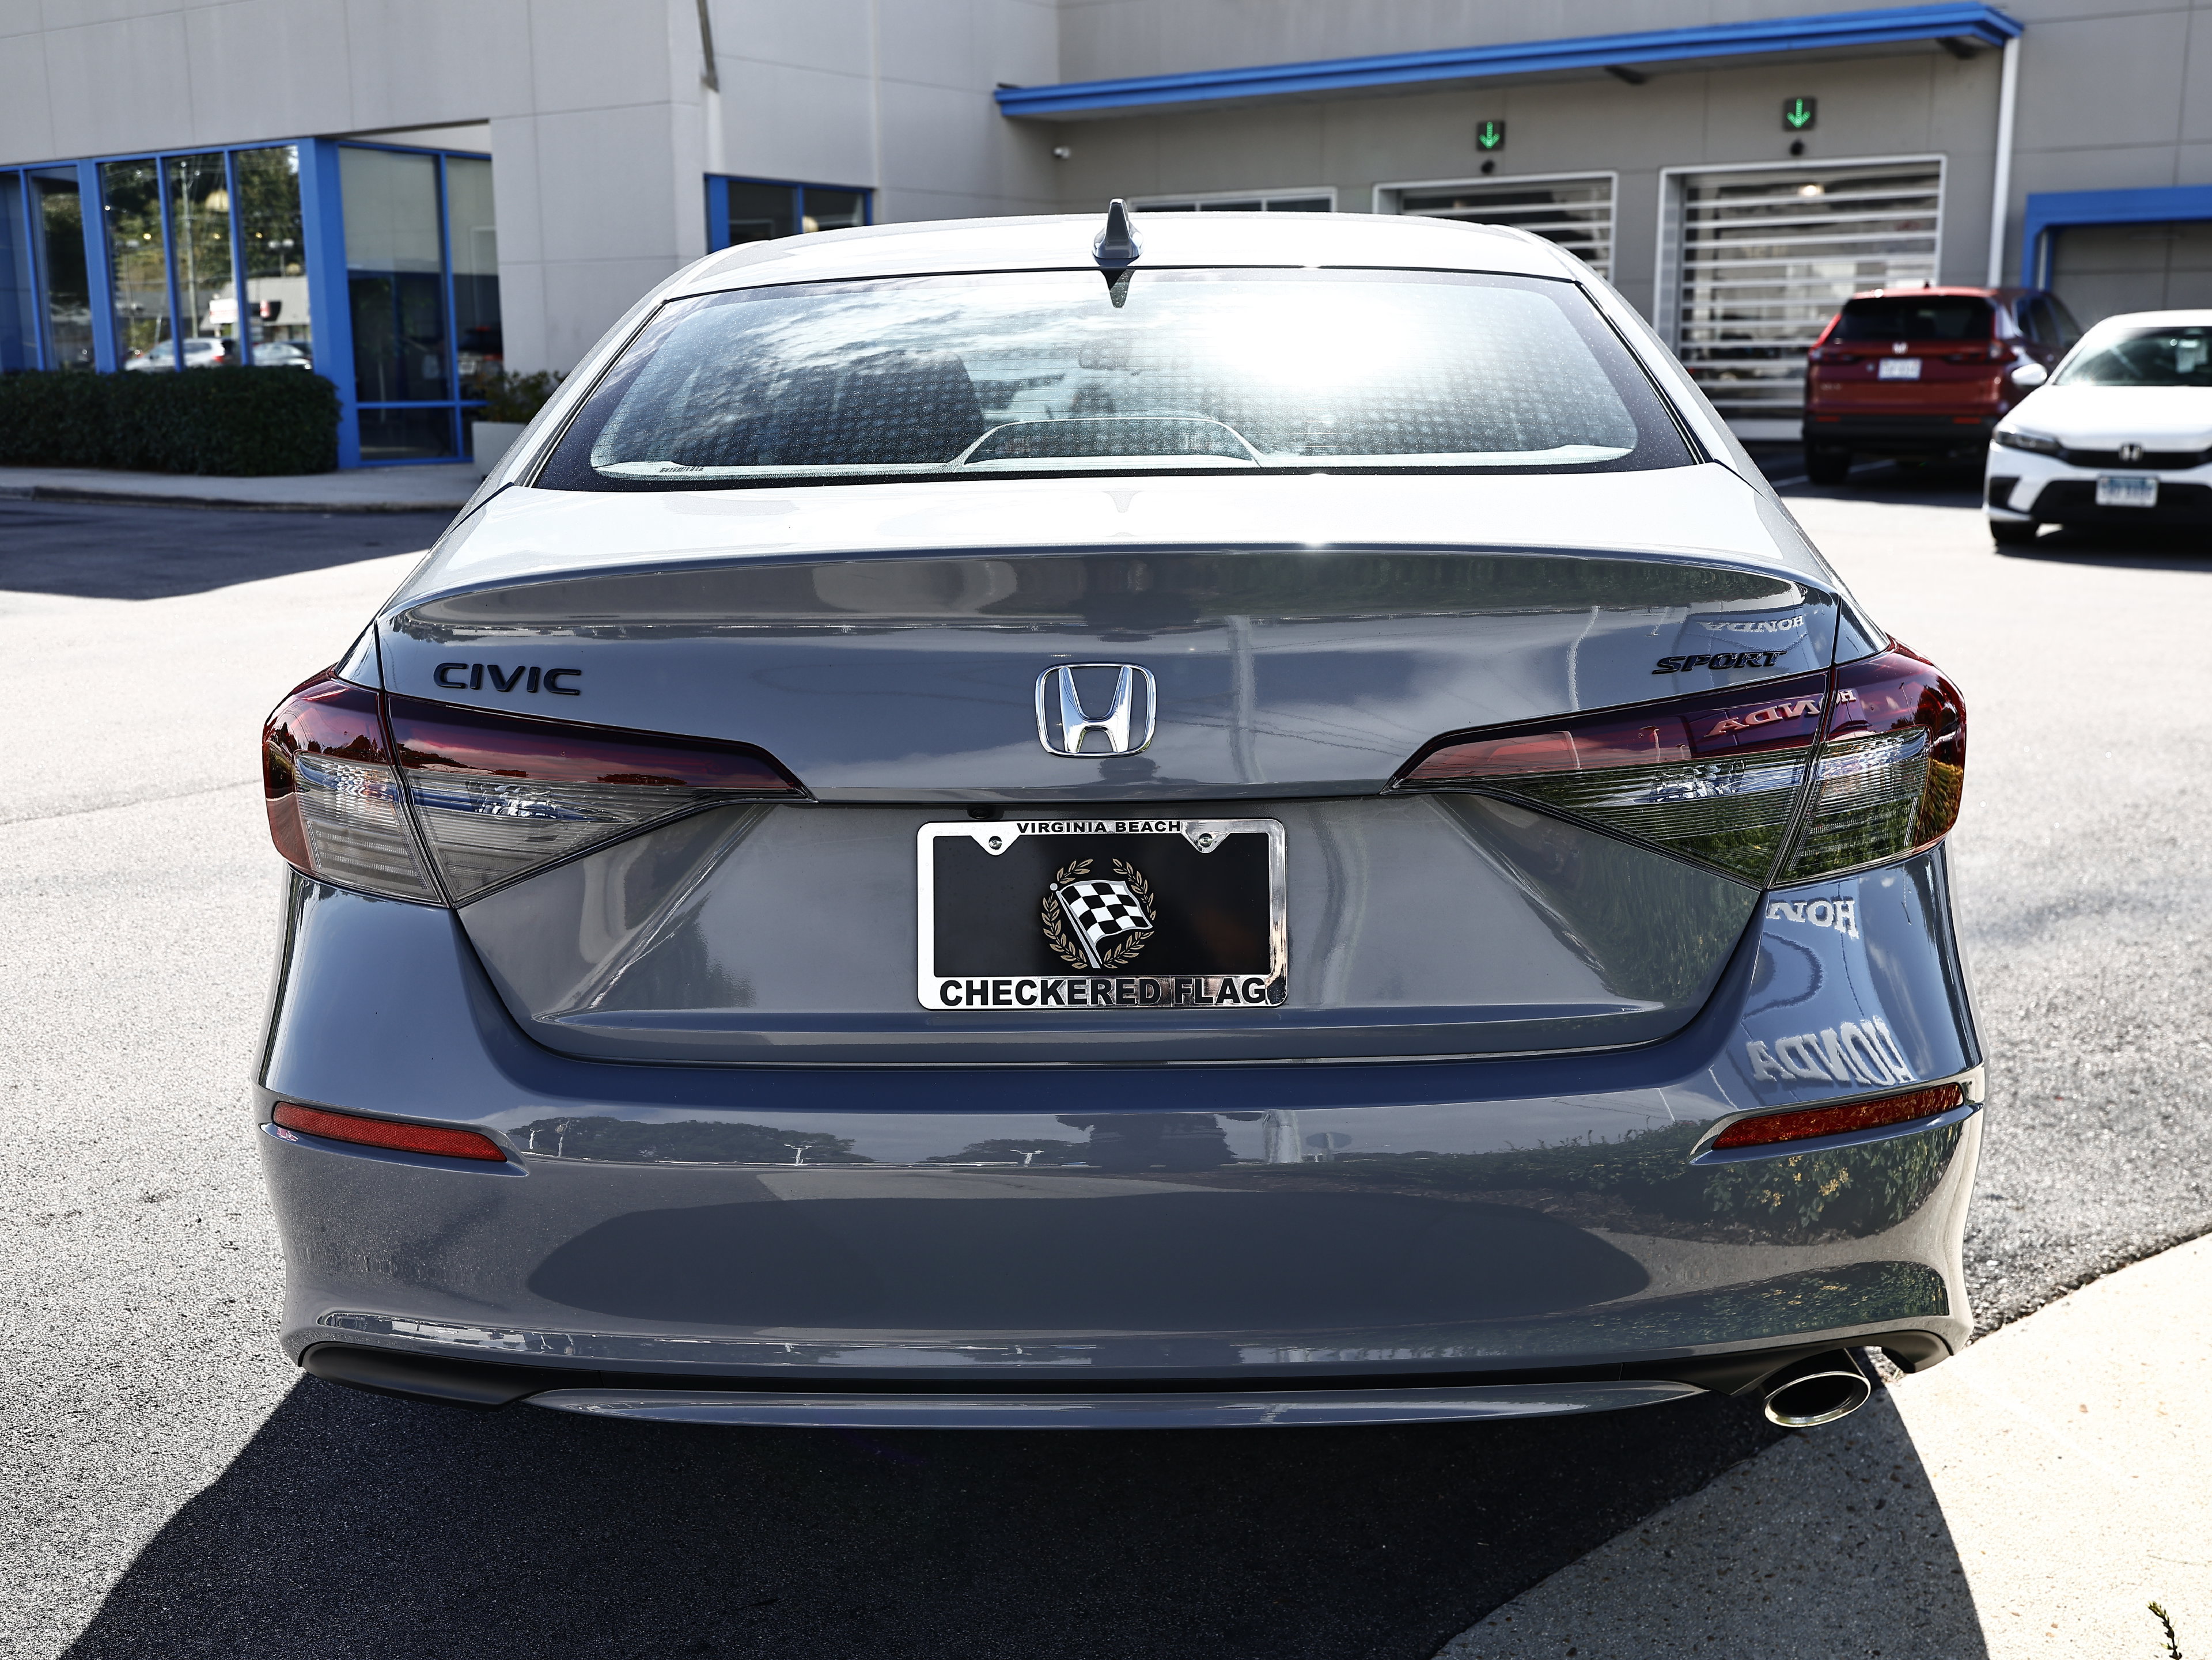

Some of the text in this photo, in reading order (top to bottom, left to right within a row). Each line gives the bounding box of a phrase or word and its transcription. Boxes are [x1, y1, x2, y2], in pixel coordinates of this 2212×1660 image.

[1652, 651, 1787, 674] SPORT
[433, 662, 581, 695] CIVIC
[1017, 821, 1180, 833] VIRGINIA BEACH
[940, 977, 1266, 1006] CHECKERED FLAG
